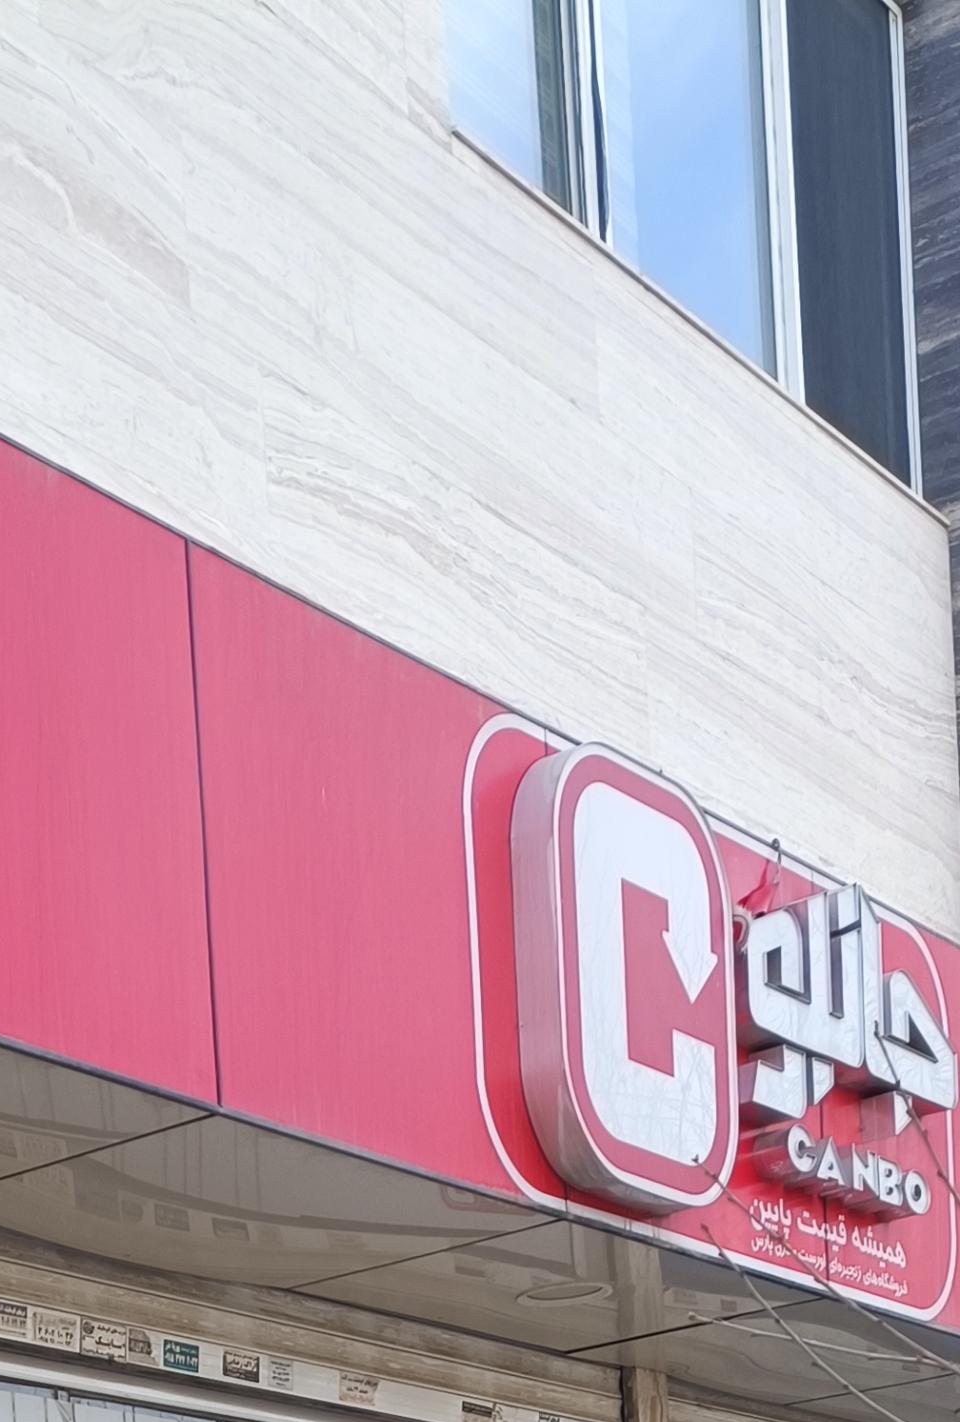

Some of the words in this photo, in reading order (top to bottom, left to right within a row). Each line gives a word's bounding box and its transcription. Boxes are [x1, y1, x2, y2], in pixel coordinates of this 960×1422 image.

[786, 1124, 929, 1214] CANBO
[750, 1198, 792, 1239] پایین
[797, 1211, 848, 1252] قیمت
[852, 1226, 907, 1268] همیشه
